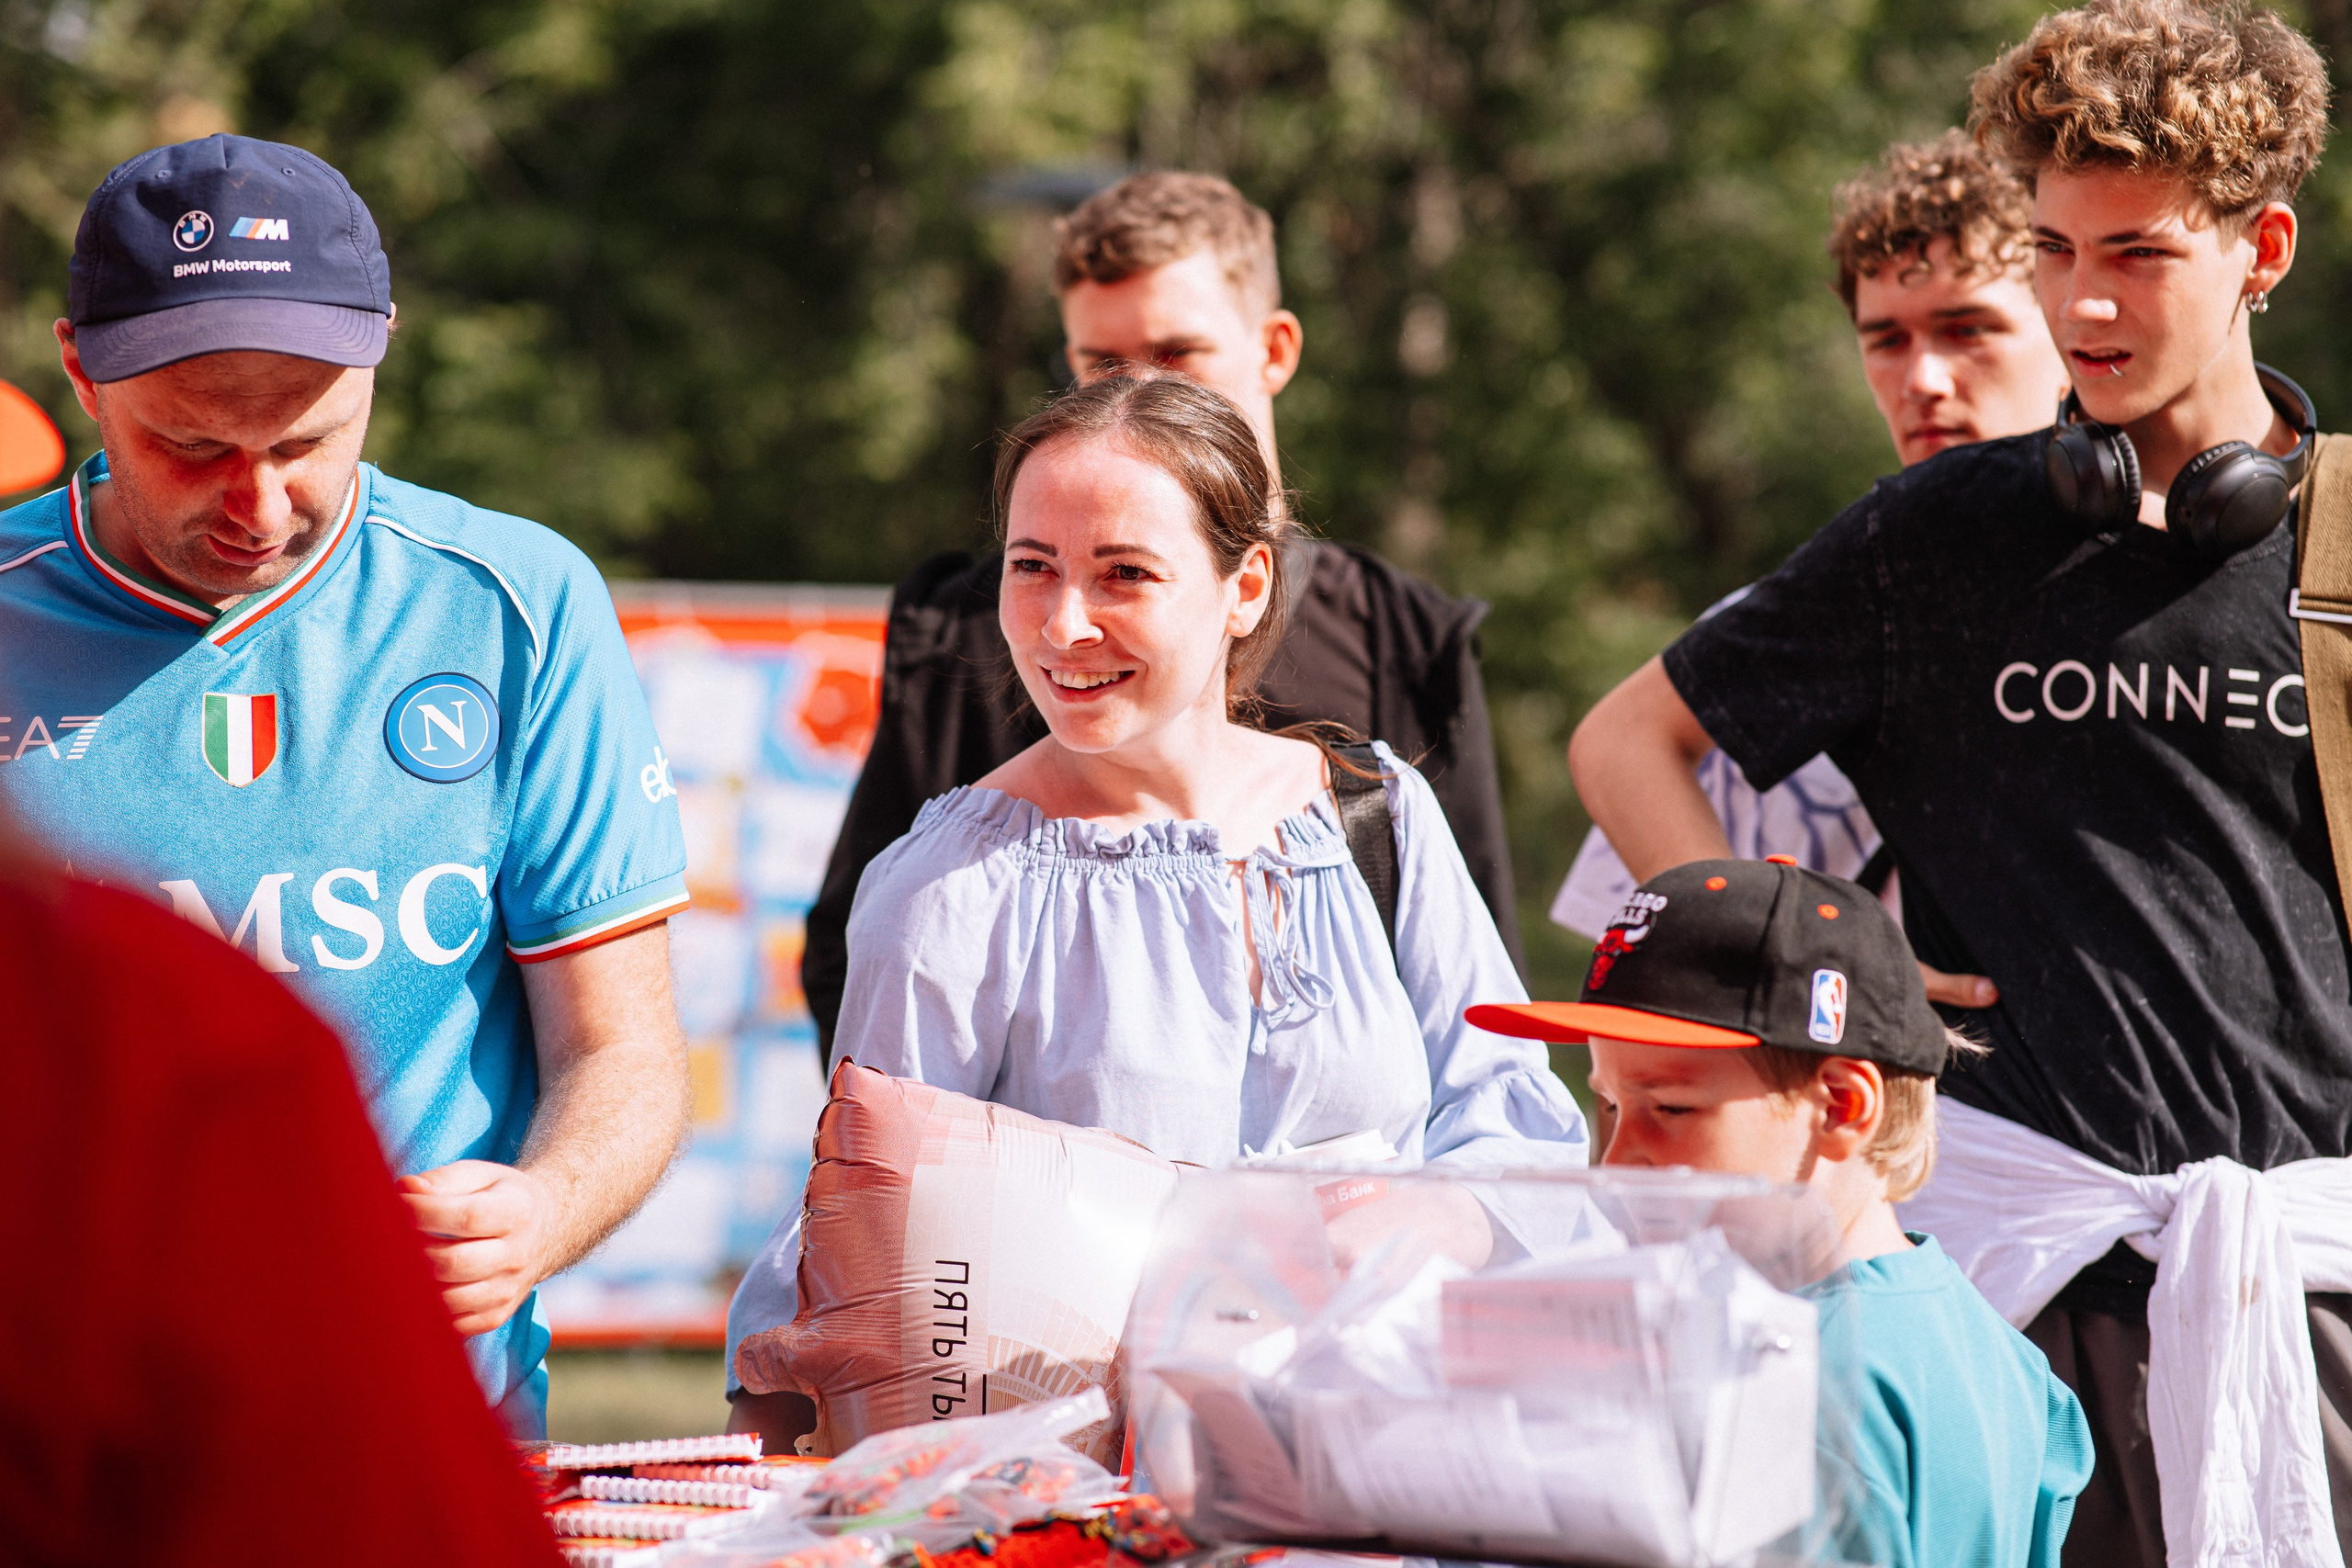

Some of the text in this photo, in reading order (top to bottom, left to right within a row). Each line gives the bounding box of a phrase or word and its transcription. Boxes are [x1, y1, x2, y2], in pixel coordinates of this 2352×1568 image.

[173, 258, 292, 278] BMW Motorsport
[416, 700, 468, 752] N
[1994, 659, 2310, 738] CONNEC
[158, 863, 488, 974] MSC
[1337, 1180, 1376, 1203] Банк
[932, 1259, 970, 1359] ПЯТЬ
